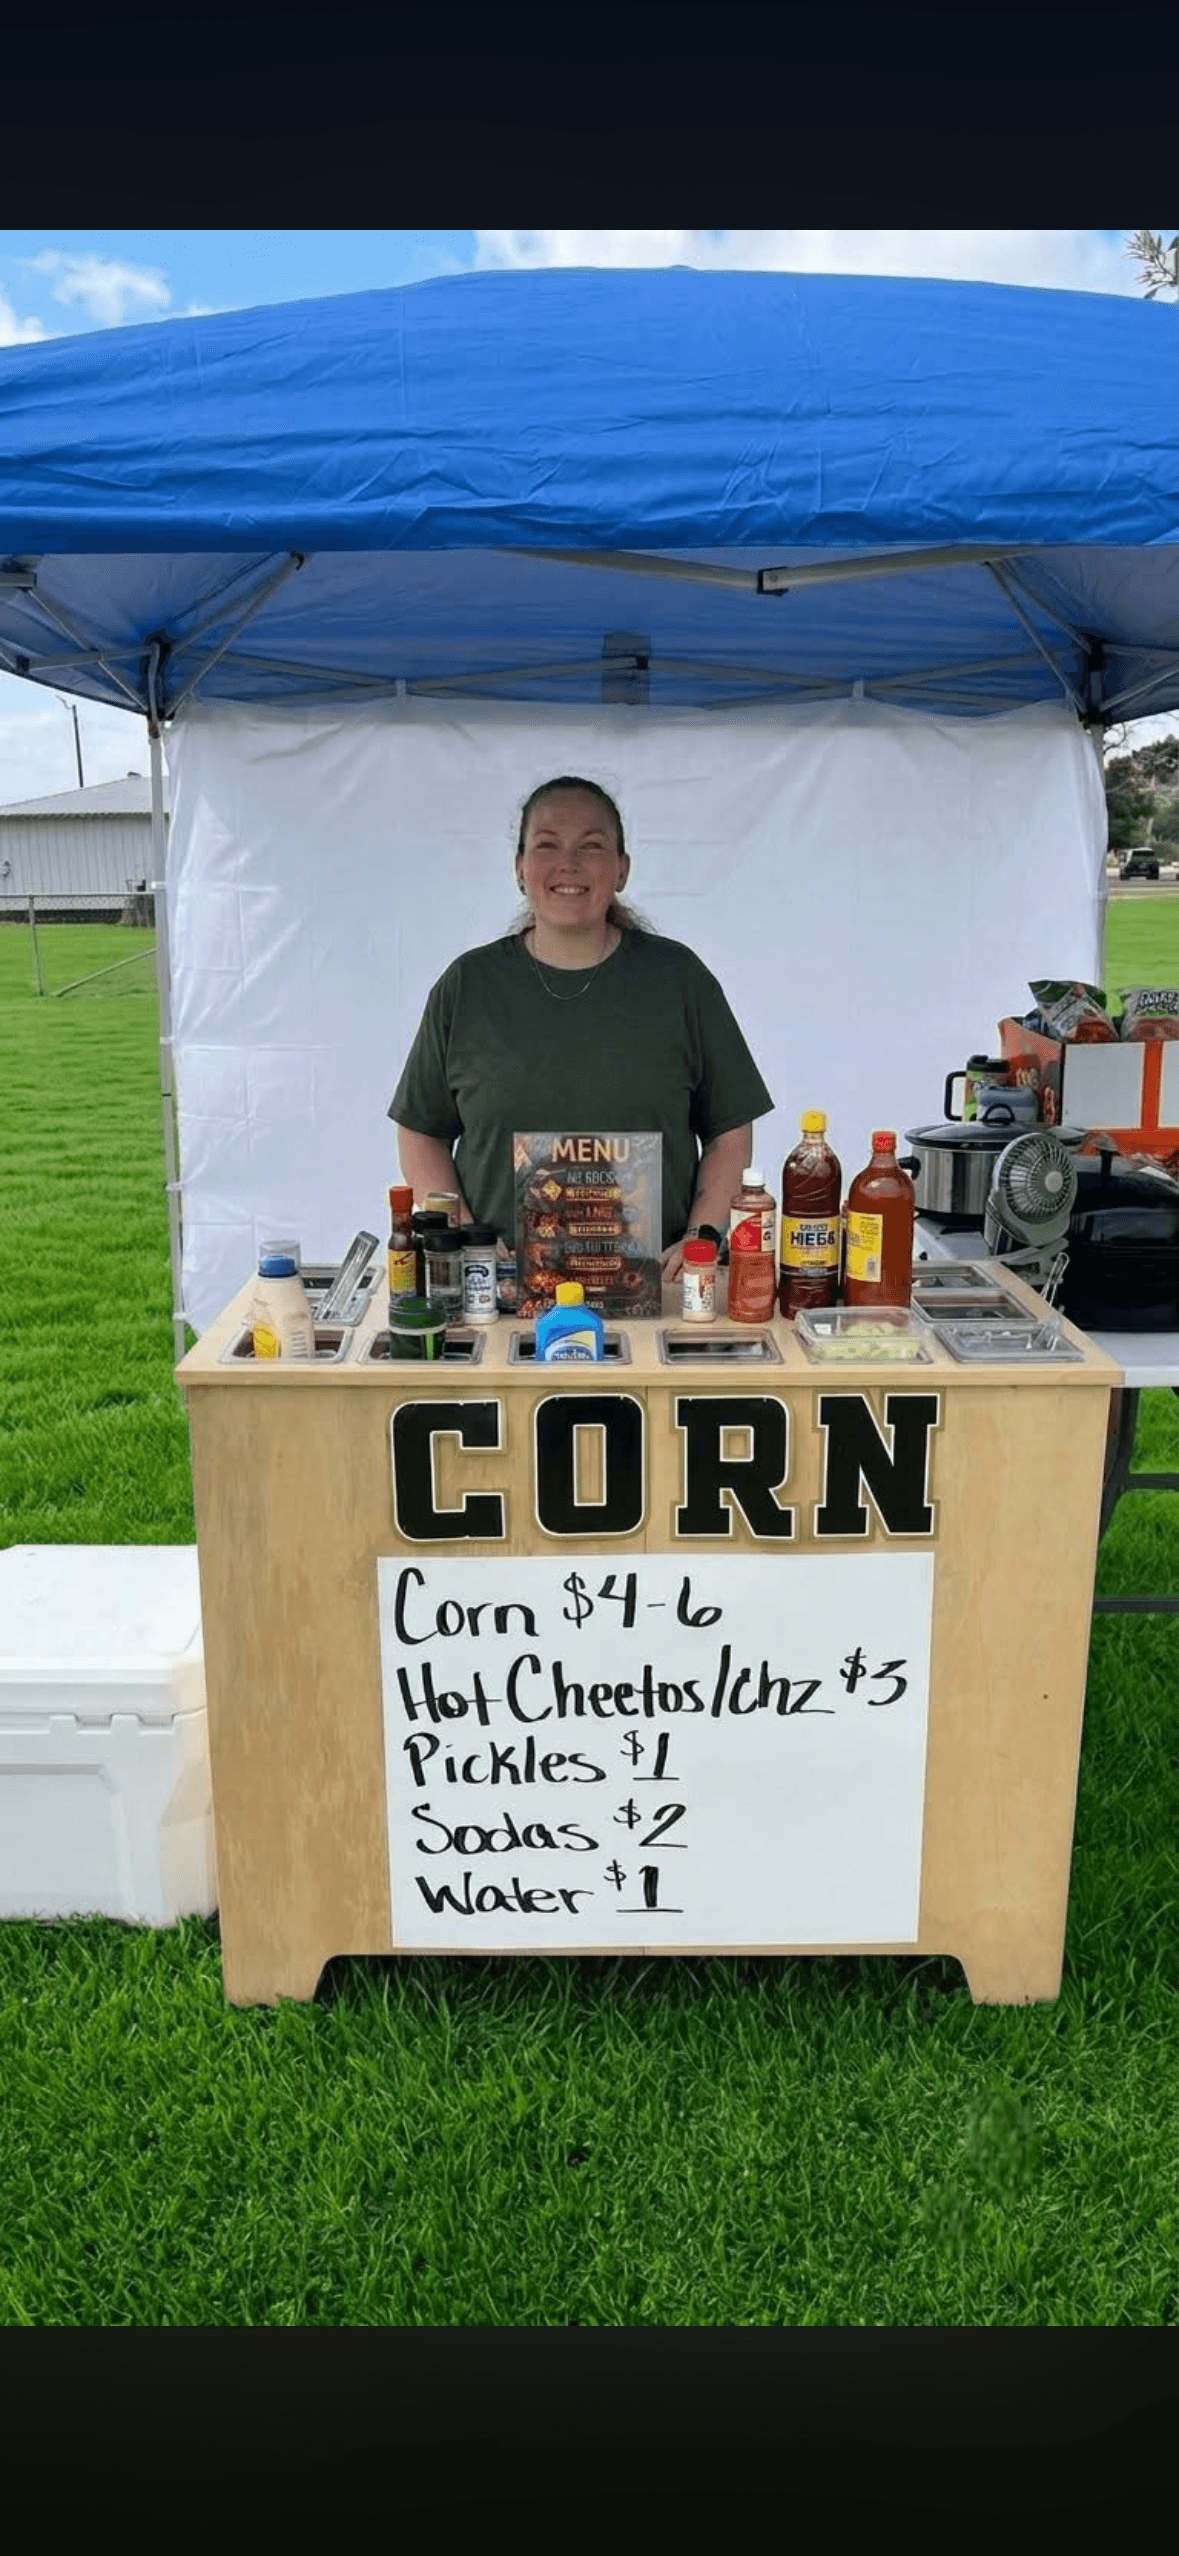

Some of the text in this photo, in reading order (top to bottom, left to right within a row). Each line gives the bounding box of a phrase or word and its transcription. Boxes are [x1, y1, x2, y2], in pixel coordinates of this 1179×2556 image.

[551, 1138, 630, 1163] MENU
[391, 1393, 940, 1540] CORN
[395, 1568, 723, 1645] Corn $4-6
[396, 1662, 502, 1726] Hot
[839, 1647, 908, 1706] $3
[403, 1730, 680, 1787] Pickles $1
[411, 1798, 688, 1855] Sodas $2
[414, 1859, 684, 1916] Water $1
